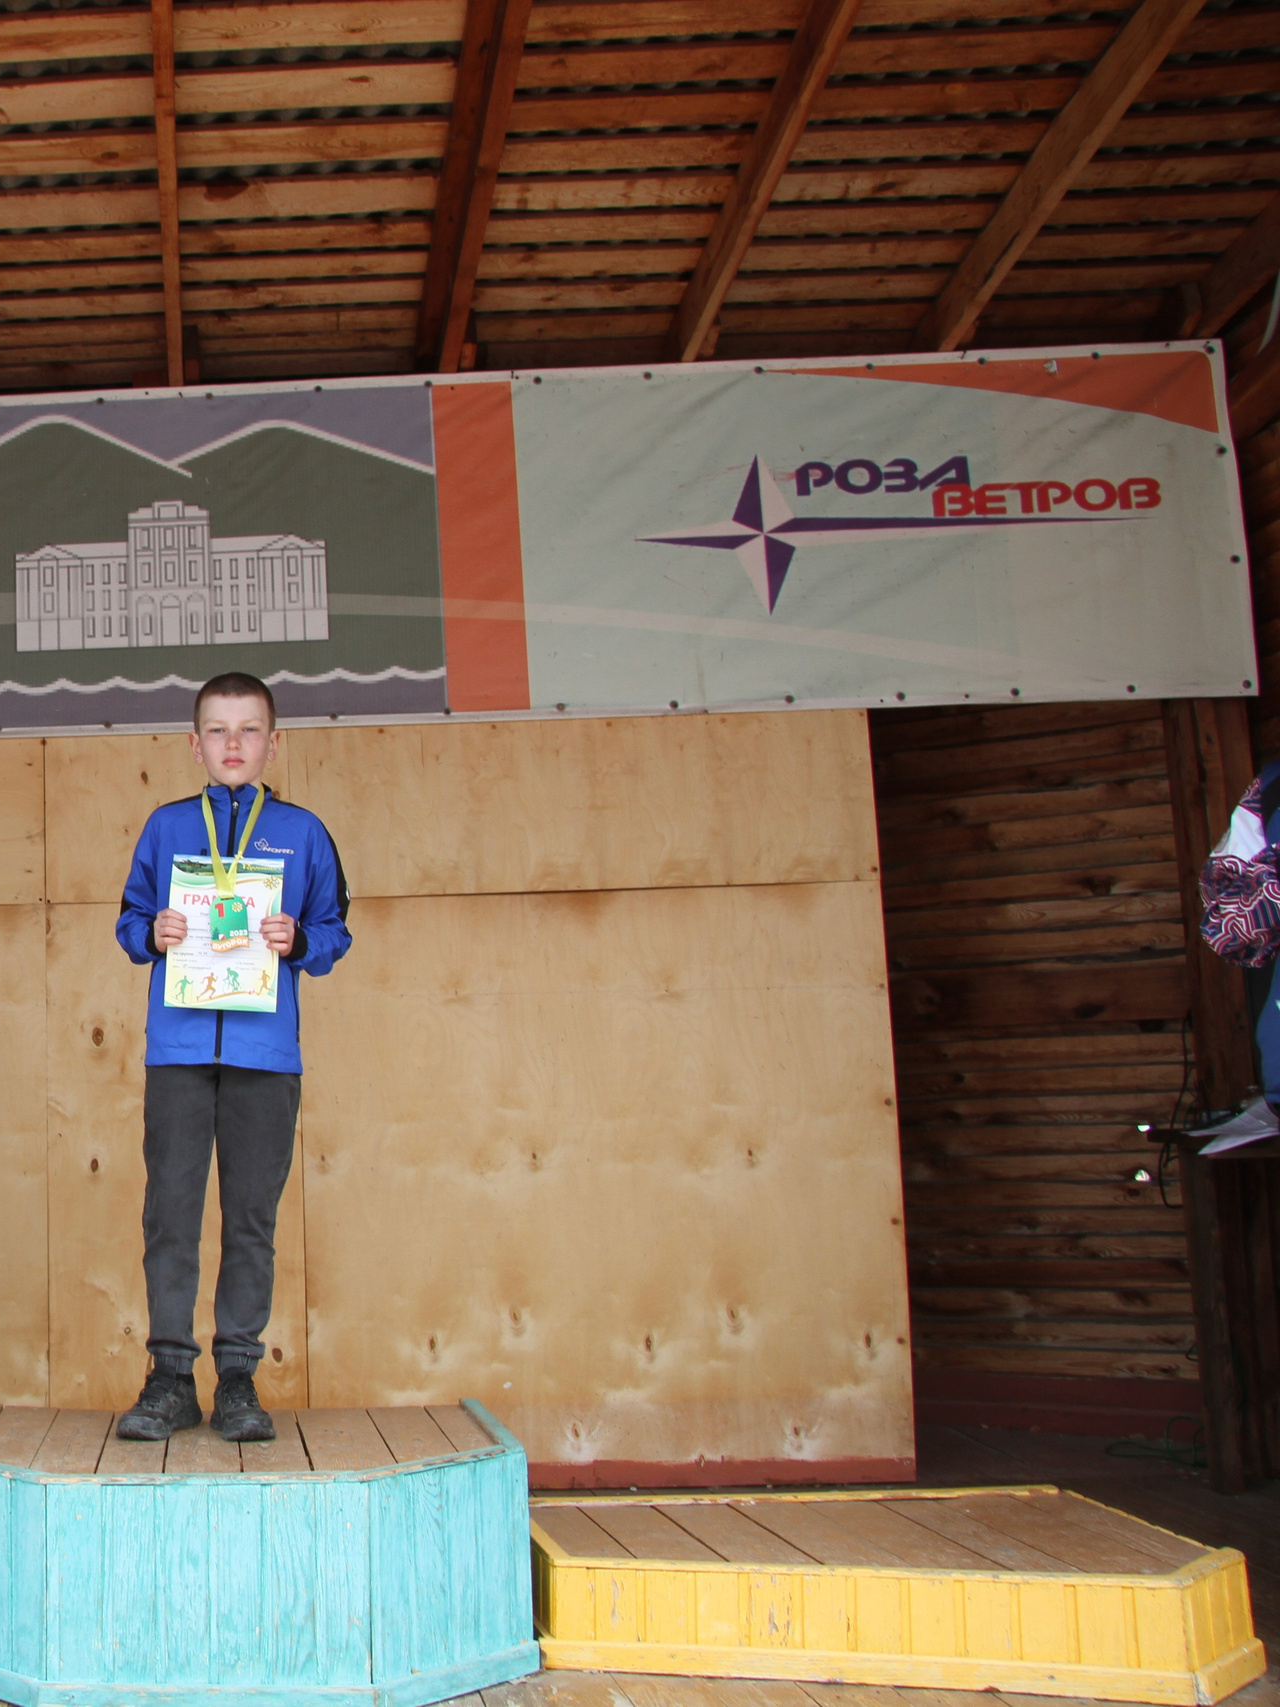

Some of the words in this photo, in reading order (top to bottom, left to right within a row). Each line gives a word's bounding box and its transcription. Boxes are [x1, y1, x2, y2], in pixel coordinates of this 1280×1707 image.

[795, 456, 970, 496] РОЗА
[932, 477, 1162, 517] ВЕТРОВ
[262, 846, 295, 855] NORD
[183, 893, 255, 908] ГРАА
[215, 903, 225, 917] 1
[229, 929, 248, 937] 2023
